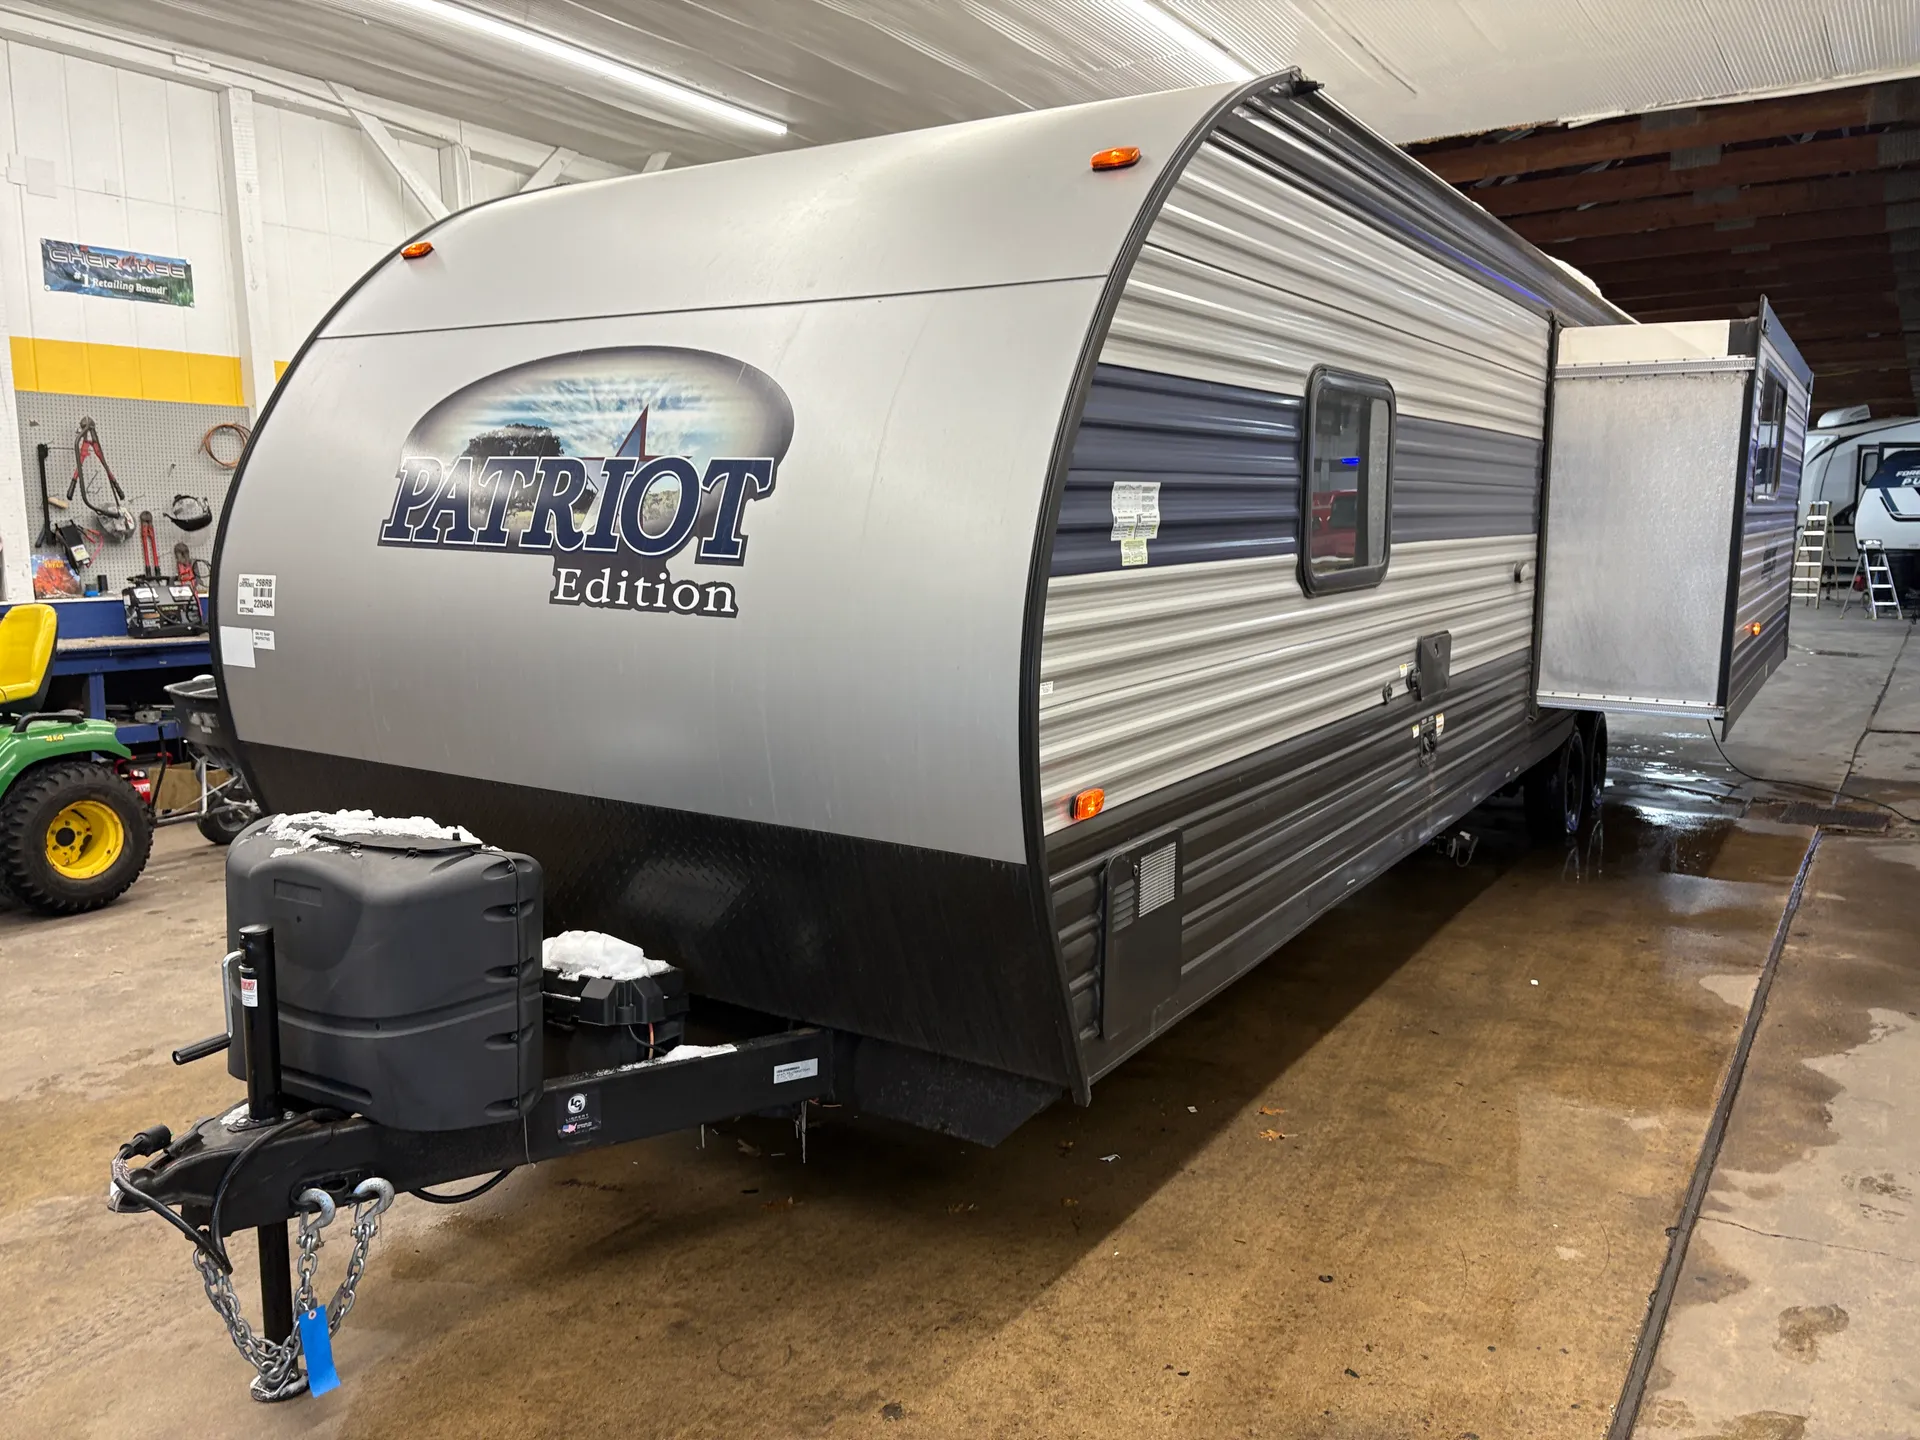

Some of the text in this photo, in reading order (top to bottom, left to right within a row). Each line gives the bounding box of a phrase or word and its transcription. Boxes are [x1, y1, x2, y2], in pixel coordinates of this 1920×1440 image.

[91, 278, 135, 292] Retailing
[381, 456, 774, 559] PATRIOT
[554, 567, 736, 614] Edition
